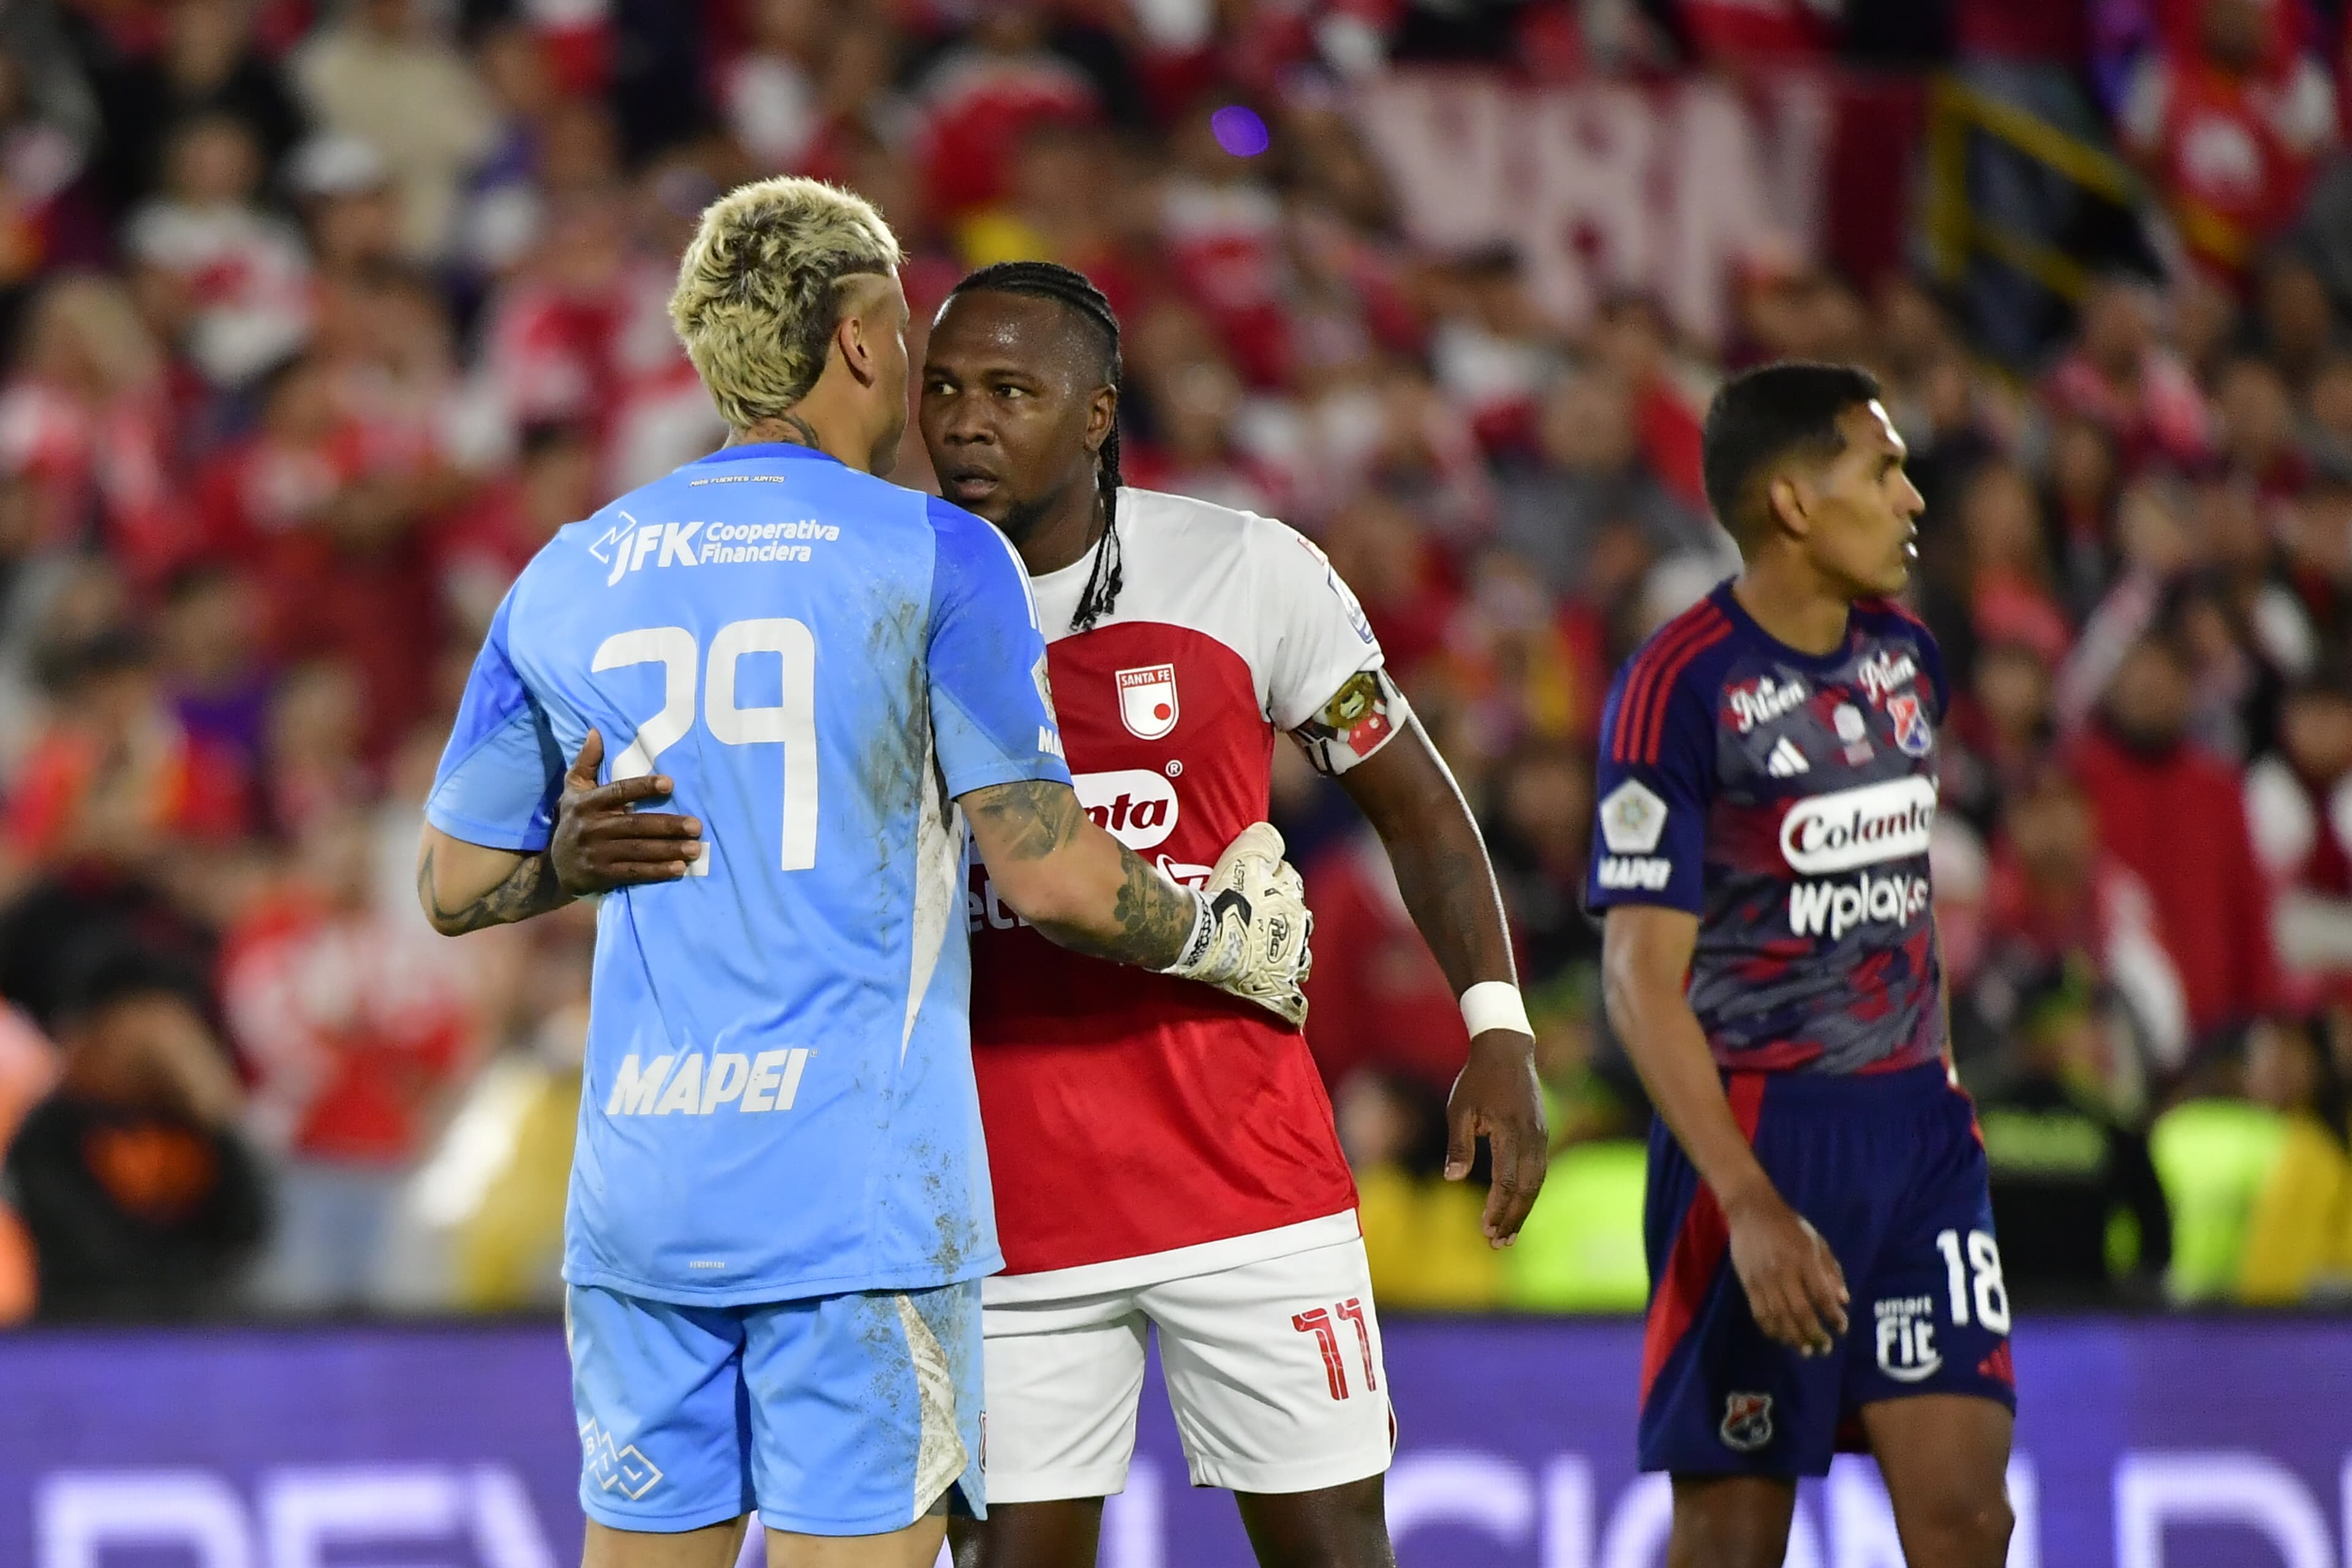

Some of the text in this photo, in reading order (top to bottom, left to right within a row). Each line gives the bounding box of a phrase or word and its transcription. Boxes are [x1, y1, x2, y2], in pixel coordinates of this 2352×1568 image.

[608, 521, 704, 587] JFK
[700, 540, 812, 565] Financiera
[706, 519, 840, 545] Cooperativa
[1121, 669, 1170, 687] SANTA FE
[591, 617, 818, 877] 29
[606, 1048, 809, 1116] MAPEI
[1936, 1229, 2011, 1336] 18
[1291, 1297, 1377, 1401] 11
